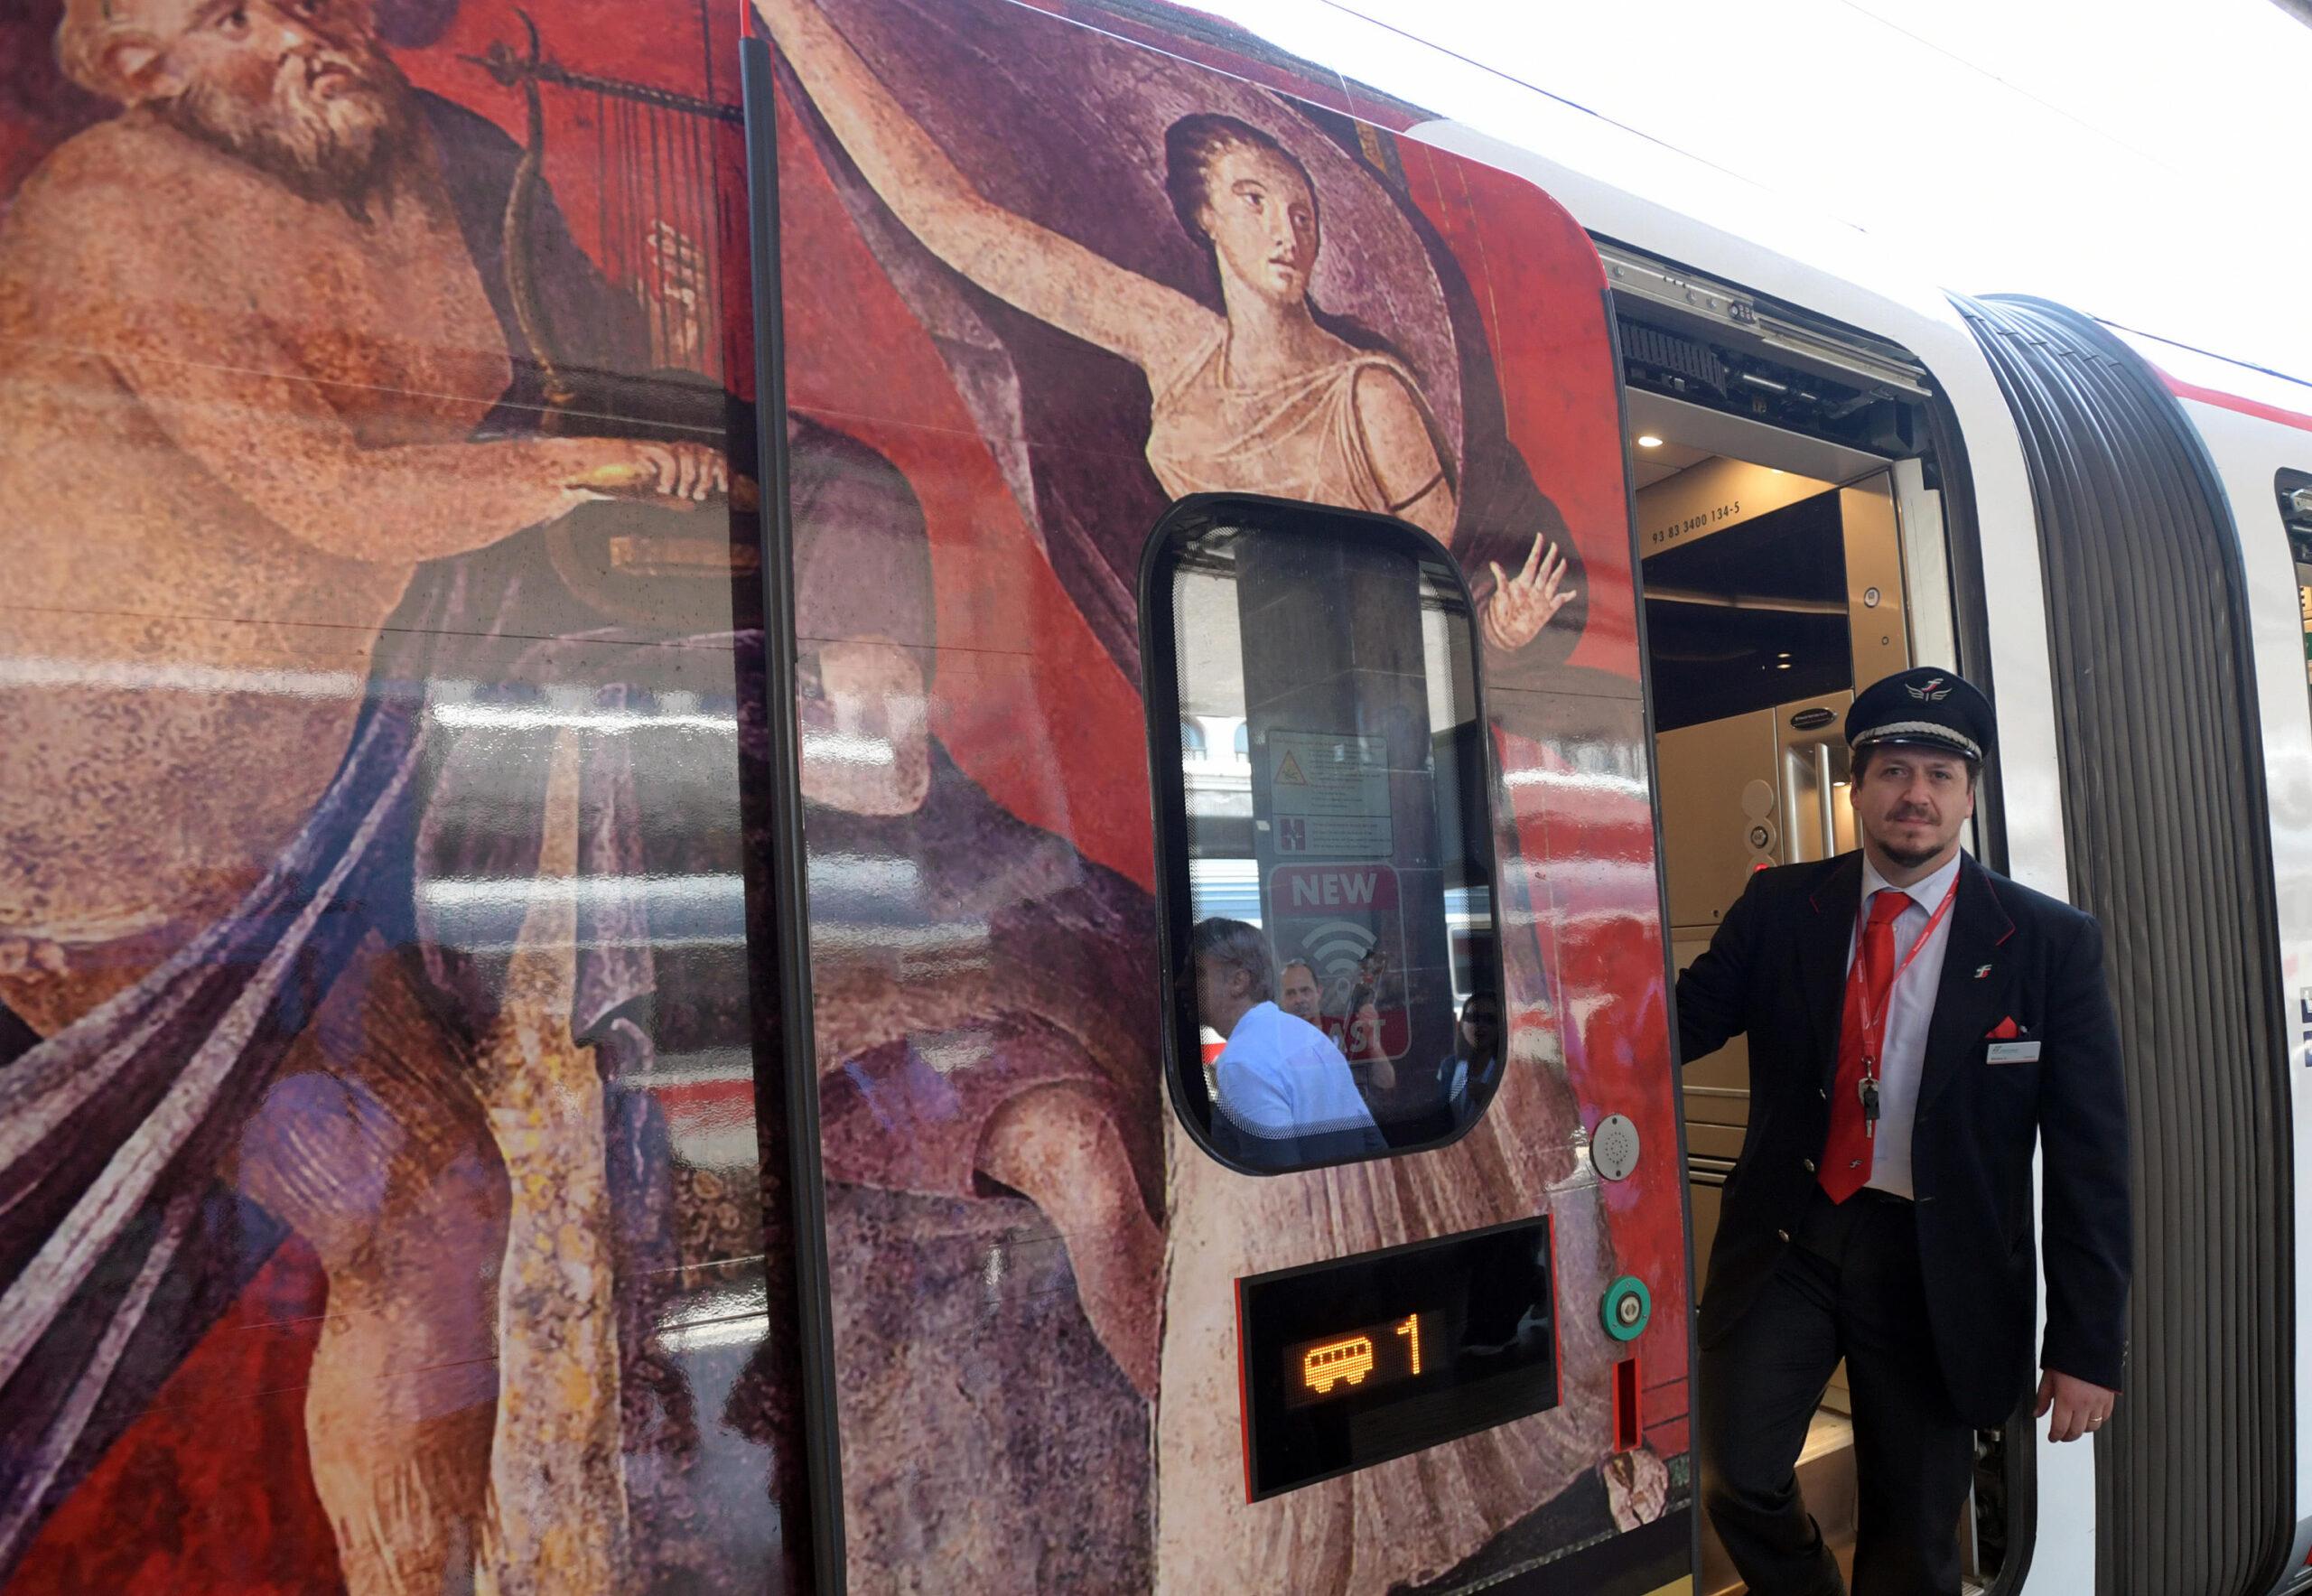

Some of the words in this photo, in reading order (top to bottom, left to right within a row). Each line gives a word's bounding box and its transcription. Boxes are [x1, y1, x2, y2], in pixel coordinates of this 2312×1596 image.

[1652, 530, 1664, 544] 93
[1668, 524, 1680, 538] 83
[1683, 513, 1708, 533] 3400
[1711, 501, 1740, 522] 134-5
[1291, 873, 1377, 906] NEW
[1321, 1019, 1387, 1053] AST
[1396, 1312, 1422, 1376] 1
